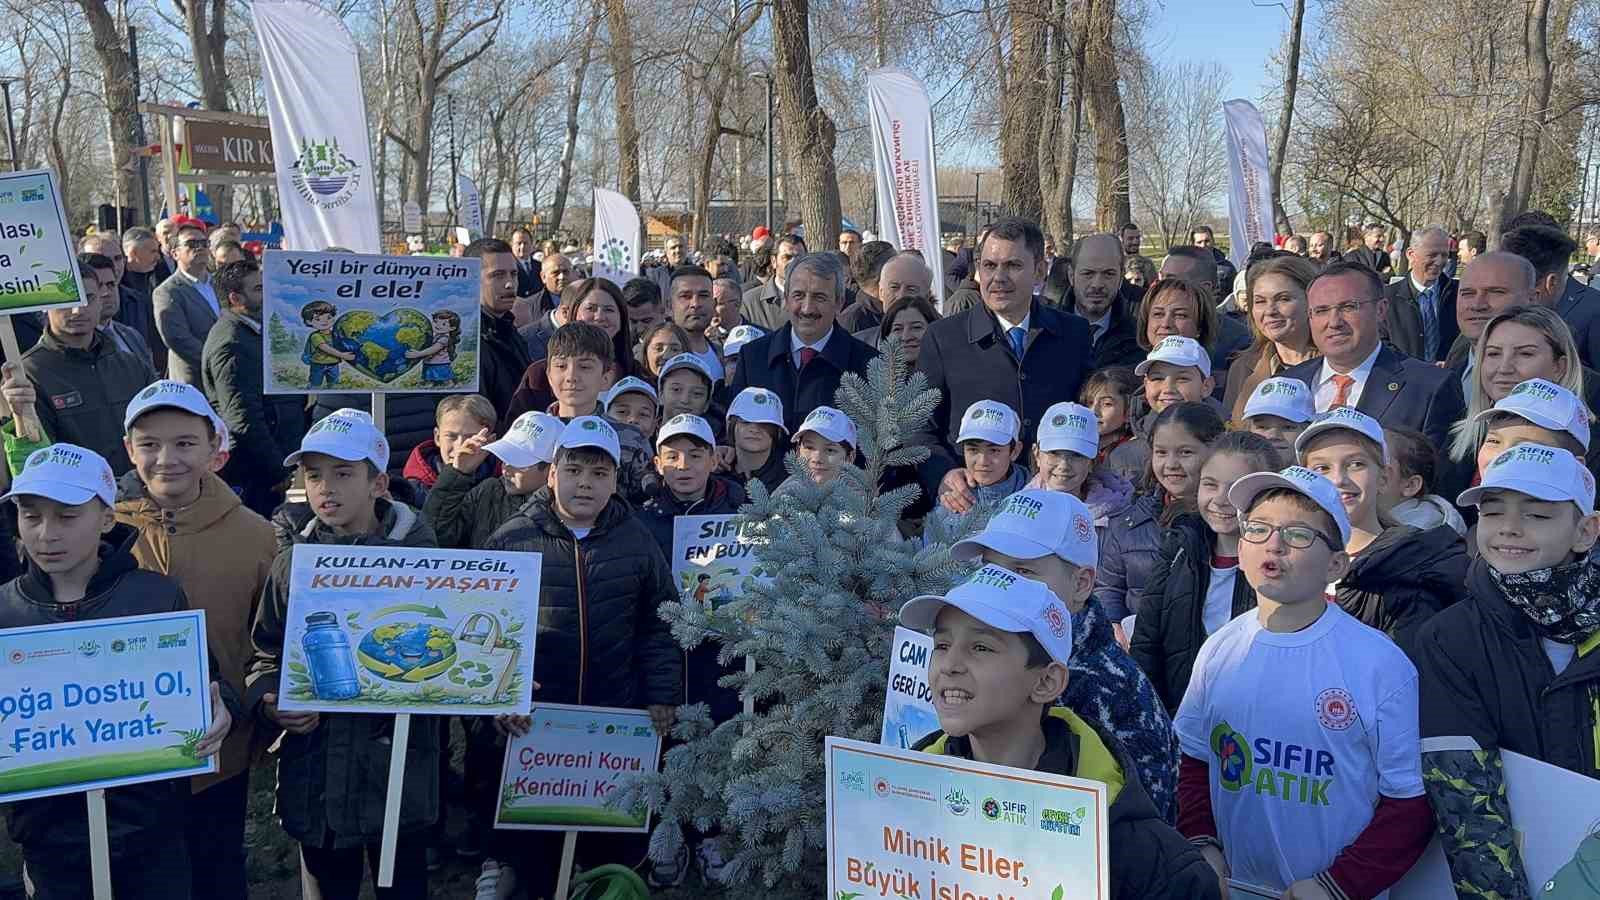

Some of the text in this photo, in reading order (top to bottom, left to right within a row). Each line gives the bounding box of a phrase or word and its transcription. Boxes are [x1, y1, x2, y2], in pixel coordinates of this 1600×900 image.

[222, 136, 256, 163] KIR
[287, 258, 467, 279] Yeşil bir dünya için
[337, 280, 424, 298] el ele!
[1528, 389, 1555, 401] ATIK
[1532, 382, 1559, 396] SIFIR
[54, 447, 82, 460] SIFIR
[1516, 453, 1552, 464] ATIK
[1520, 446, 1555, 458] SIFIR
[51, 457, 80, 469] ATIK
[1012, 494, 1043, 511] SIFIR
[1007, 505, 1040, 520] ATIK
[685, 545, 709, 560] EN
[314, 556, 516, 574] KULLAN-AT DEĞİL,
[311, 574, 519, 593] KULLAN-YAŞAT!
[972, 575, 1008, 591] ATIK
[980, 567, 1016, 585] SIFIR
[900, 641, 927, 668] CAM
[63, 678, 145, 707] Dostu
[154, 671, 192, 697] Ol,
[892, 673, 917, 696] GERİ
[14, 714, 162, 753] Fark Yarat.
[519, 747, 592, 770] Çevreni
[1254, 738, 1335, 776] SIFIR
[514, 776, 588, 797] Kendini
[1255, 768, 1333, 806] ATIK
[1002, 801, 1027, 814] SIFIR
[1002, 812, 1027, 825] ATIK
[883, 826, 1030, 887] Minik Eller,
[847, 857, 921, 899] Büyük
